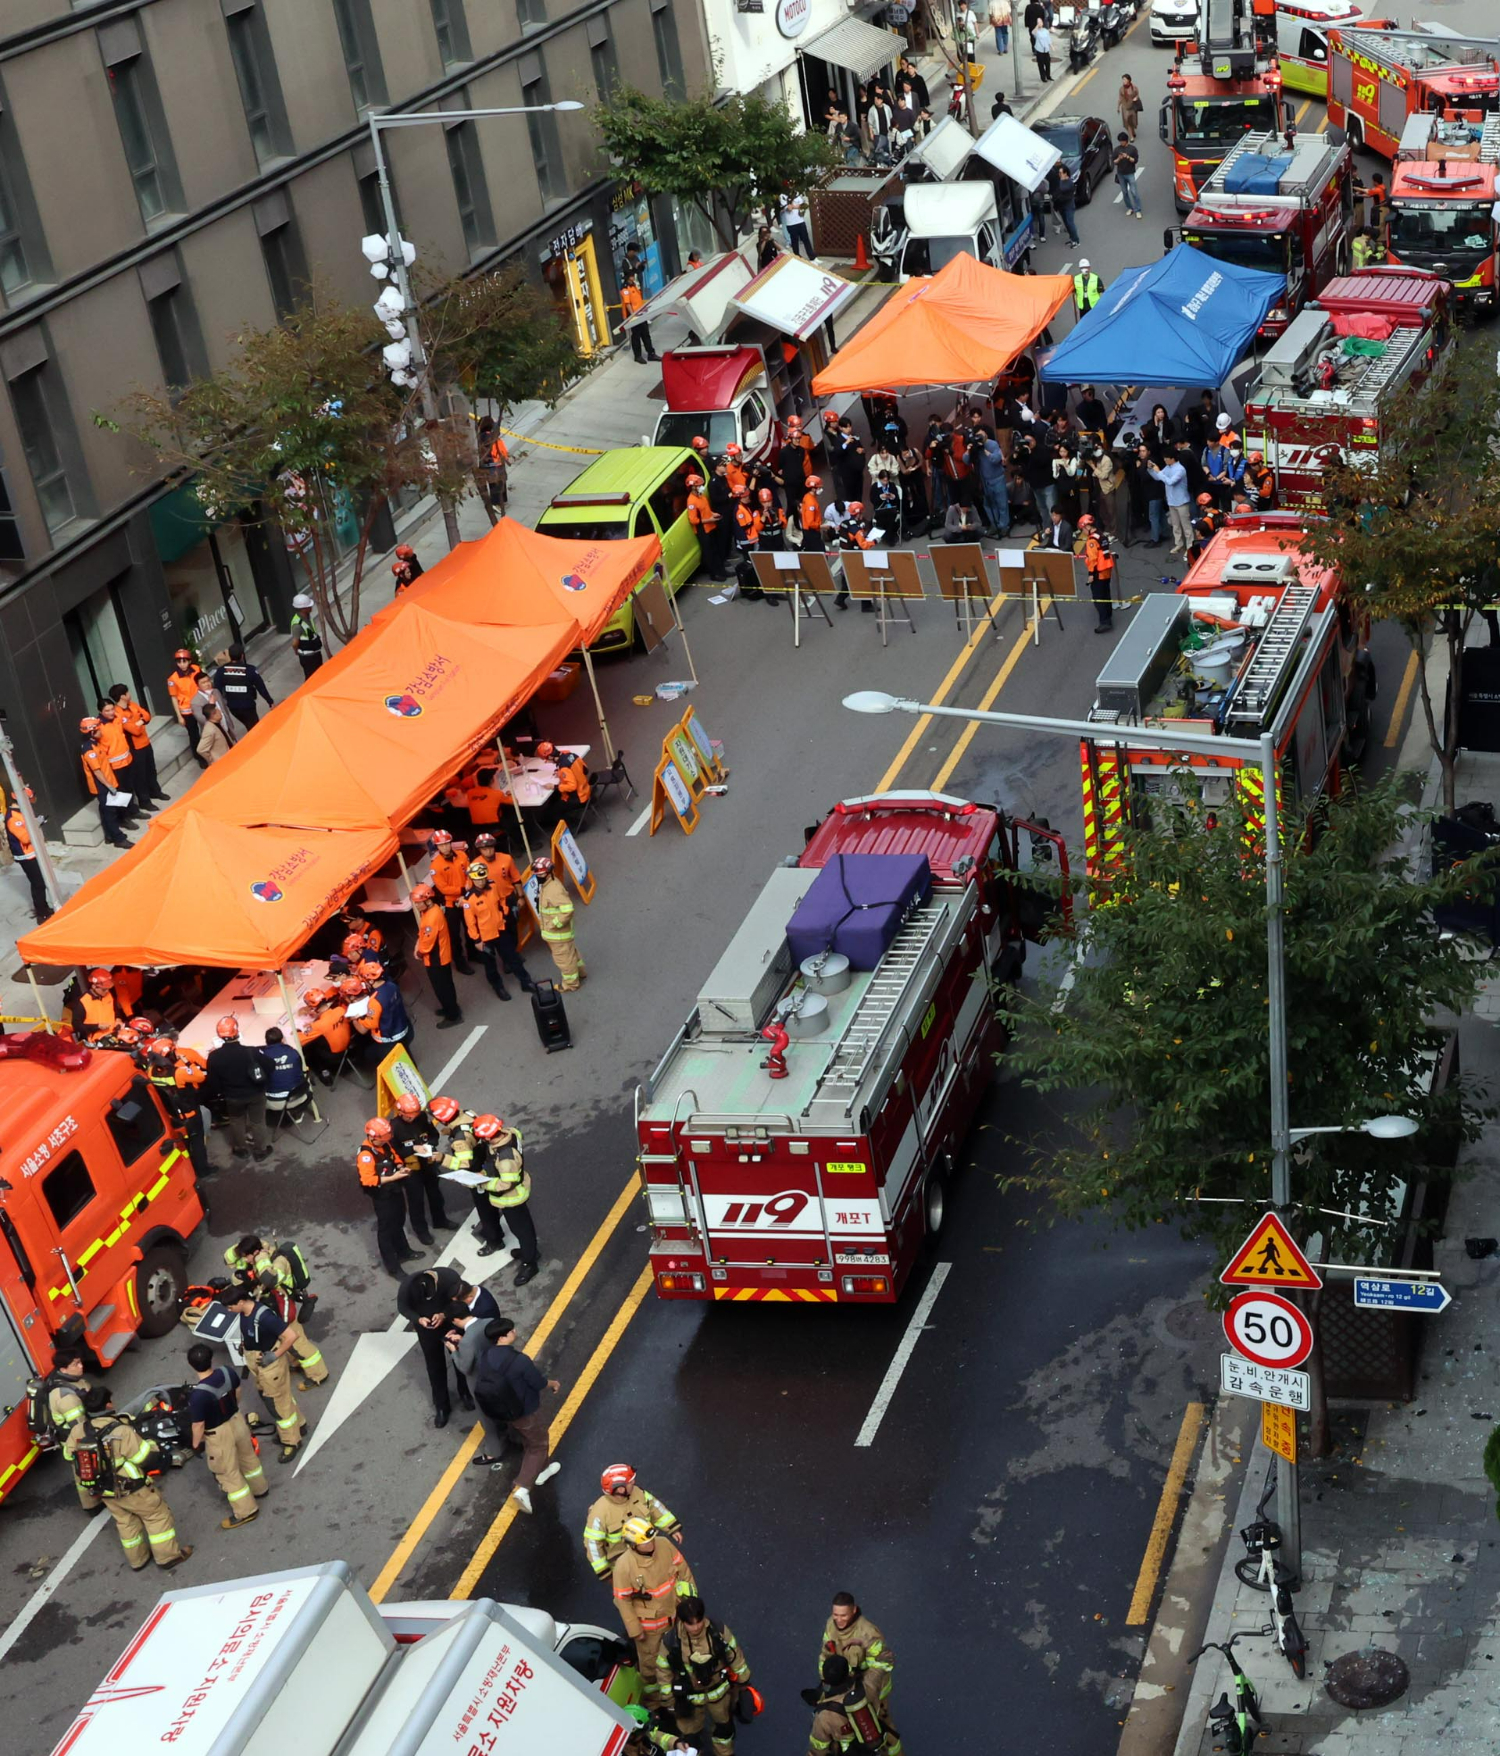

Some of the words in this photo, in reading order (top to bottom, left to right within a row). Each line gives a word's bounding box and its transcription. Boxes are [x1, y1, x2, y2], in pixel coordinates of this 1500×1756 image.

[1357, 83, 1376, 105] 119
[552, 221, 584, 257] 전자담배
[820, 276, 838, 297] 119
[1287, 442, 1340, 467] 119
[572, 547, 604, 574] 강남소방서
[405, 653, 452, 695] 강남소방서
[269, 847, 314, 881] 강남소방서
[20, 1143, 50, 1178] 서울소방
[47, 1115, 79, 1149] 서초구조
[829, 1163, 845, 1172] 개포
[719, 1191, 809, 1228] 119
[835, 1212, 872, 1225] 개포T
[863, 1255, 887, 1264] 4283
[1360, 1282, 1391, 1292] 역삼로
[1410, 1284, 1435, 1297] 12길
[1244, 1311, 1293, 1348] 50
[1280, 1404, 1292, 1457] 단속중
[207, 1592, 274, 1673] 임시의료소
[160, 1675, 219, 1743] 지원차량
[452, 1695, 484, 1743] 서울특별시
[478, 1644, 512, 1698] 소방재난본부
[487, 1658, 534, 1730] 지원차량
